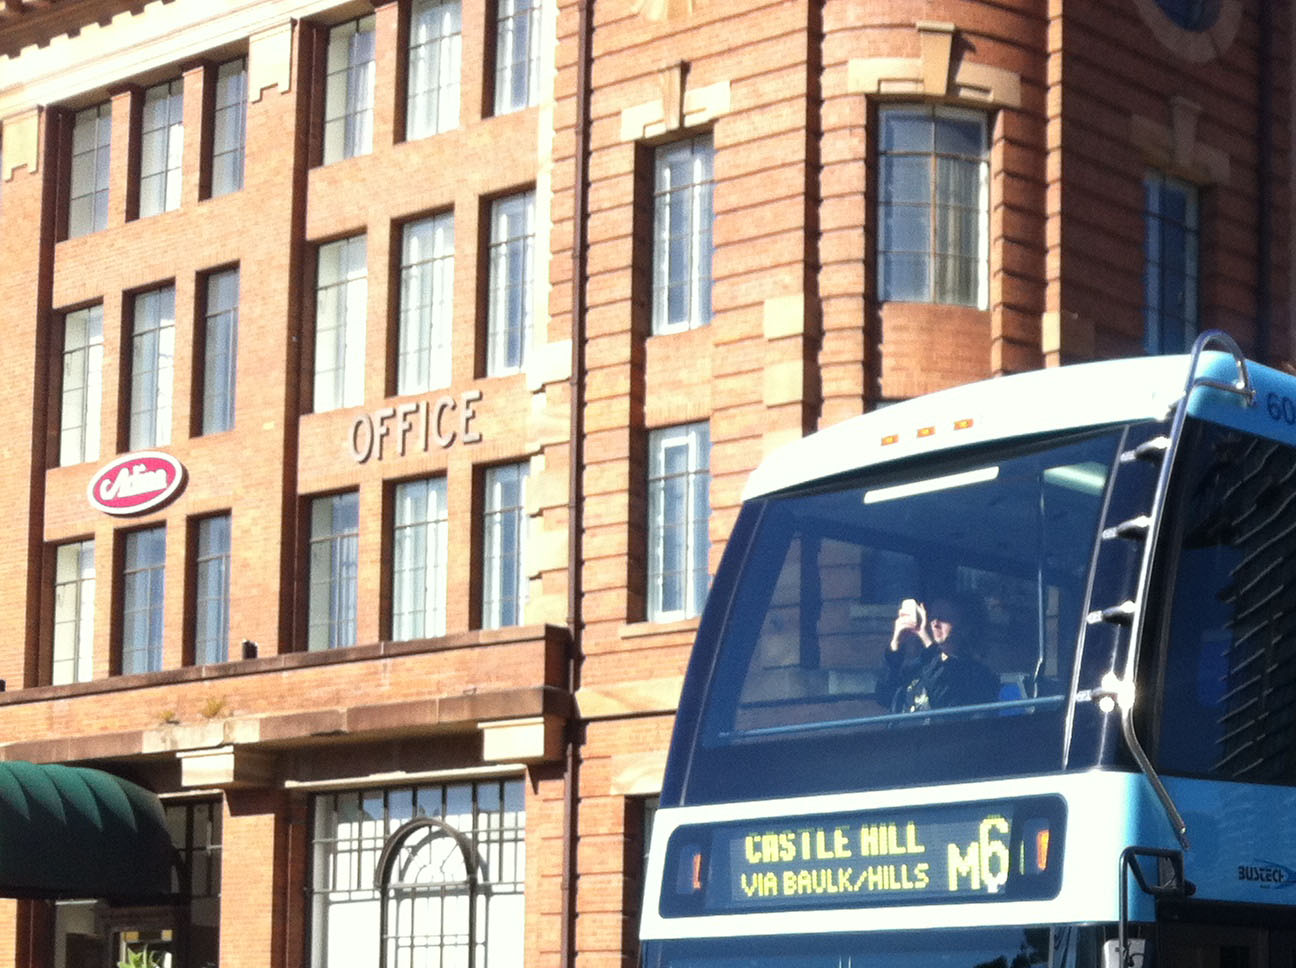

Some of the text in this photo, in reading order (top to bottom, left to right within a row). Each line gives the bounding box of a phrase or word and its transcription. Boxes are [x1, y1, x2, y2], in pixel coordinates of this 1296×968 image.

[349, 389, 483, 464] OFFICE
[745, 822, 926, 864] CASTLE HILL
[947, 815, 1010, 893] M6
[741, 862, 930, 897] VIA BAULK/HILLS
